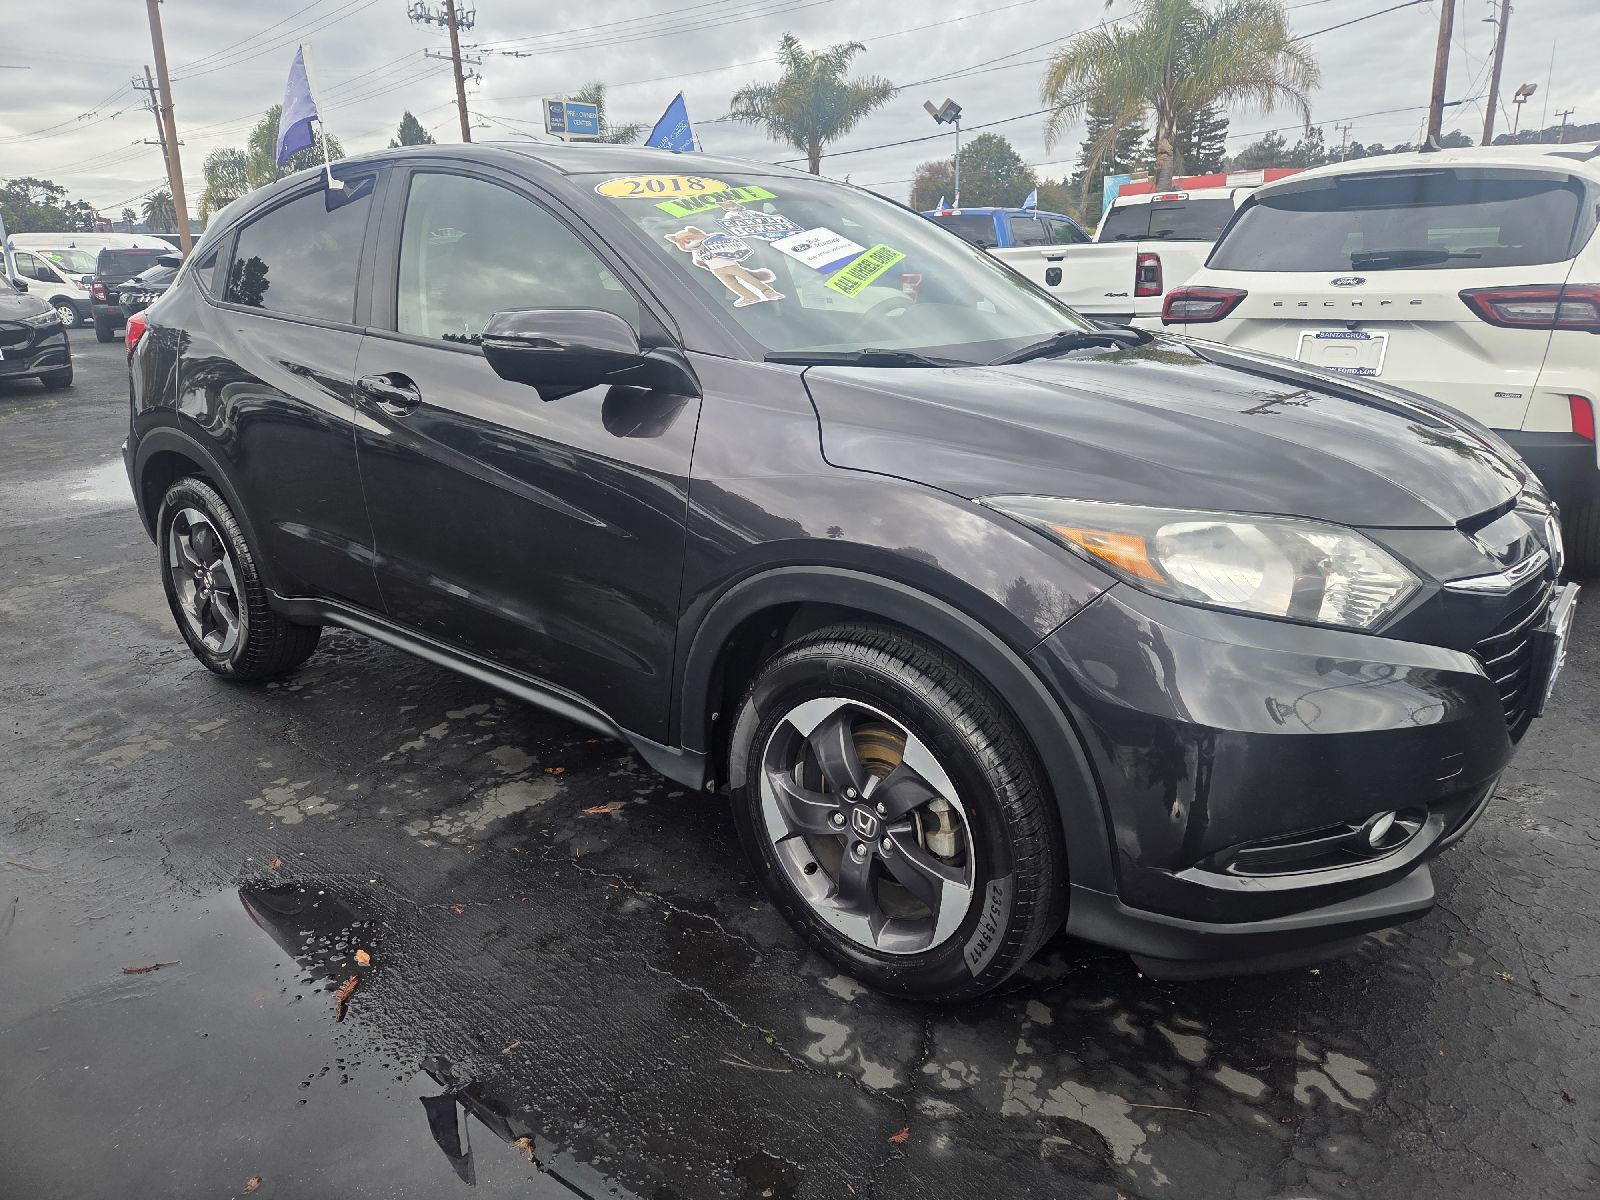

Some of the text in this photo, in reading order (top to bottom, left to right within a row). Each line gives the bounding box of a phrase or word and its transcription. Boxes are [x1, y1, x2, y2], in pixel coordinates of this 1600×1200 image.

[573, 119, 592, 127] CENTER
[624, 177, 706, 195] 2018
[870, 246, 898, 267] DRIVE
[846, 258, 880, 282] WHEEL
[833, 276, 860, 294] ALL
[1273, 299, 1423, 307] ESCAPE
[1319, 331, 1367, 340] SANTA CRUZ
[969, 885, 1004, 966] 235/55R17
